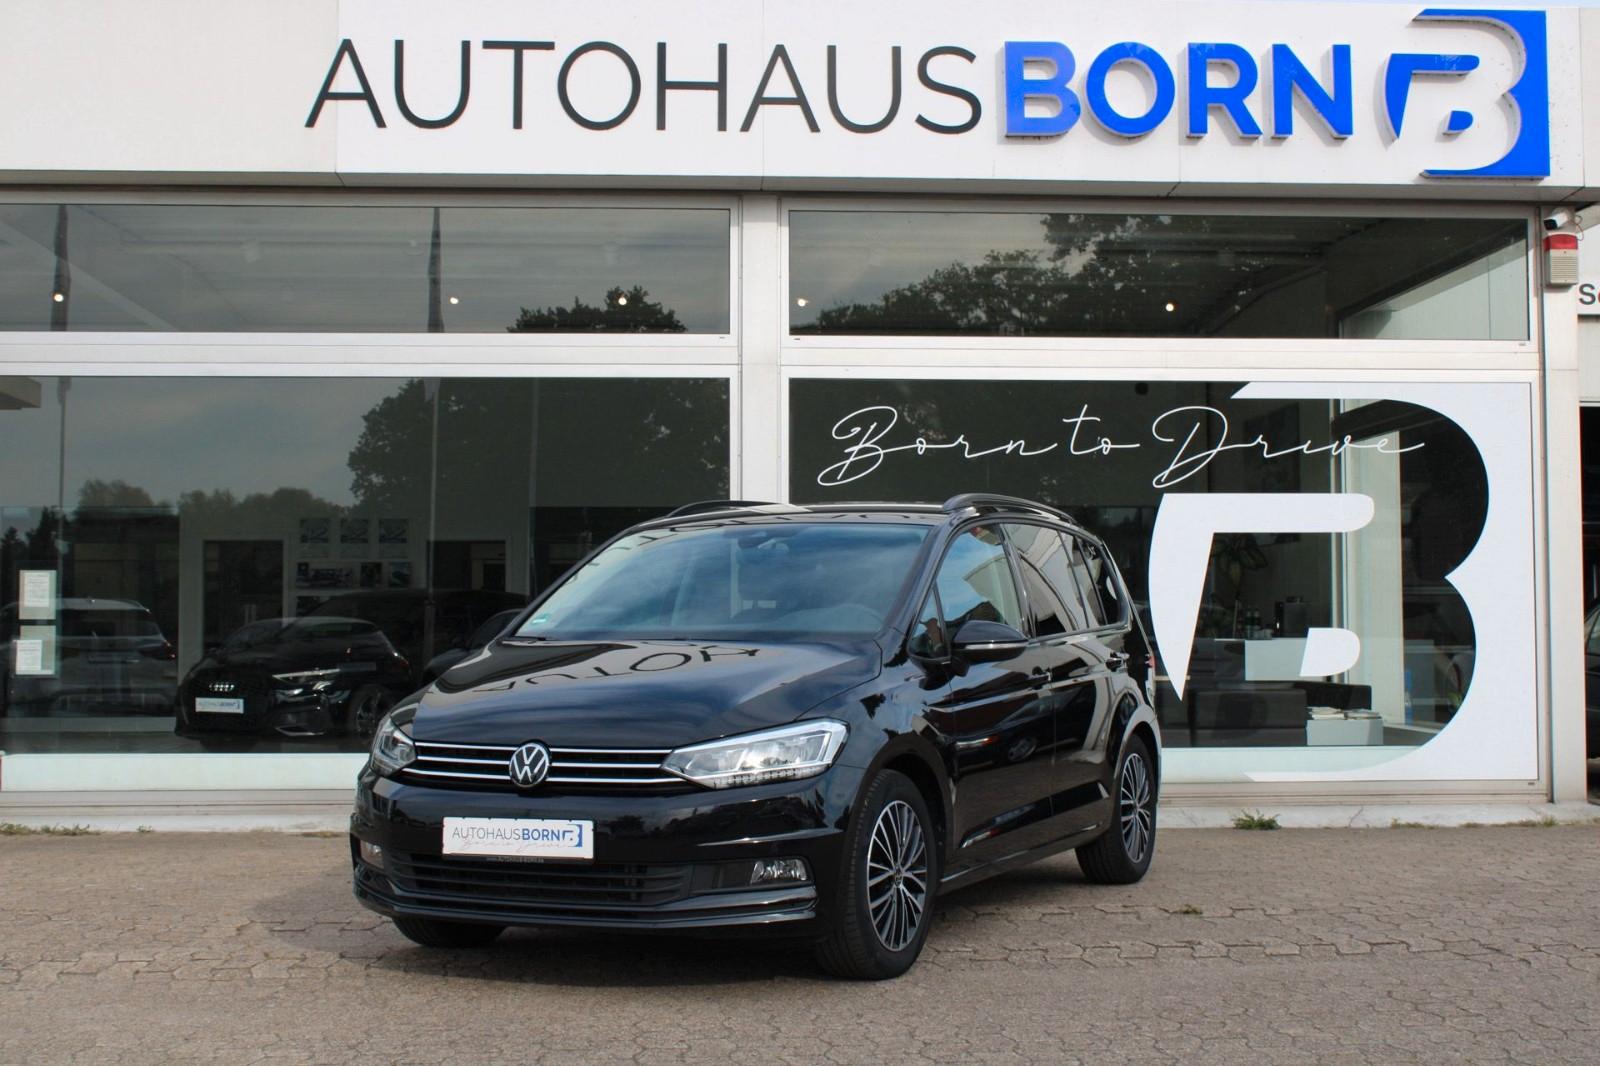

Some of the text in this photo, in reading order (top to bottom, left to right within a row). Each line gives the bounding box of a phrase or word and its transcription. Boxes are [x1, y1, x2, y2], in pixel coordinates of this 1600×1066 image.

[1579, 283, 1600, 305] S
[817, 404, 1425, 488] Born to Drive
